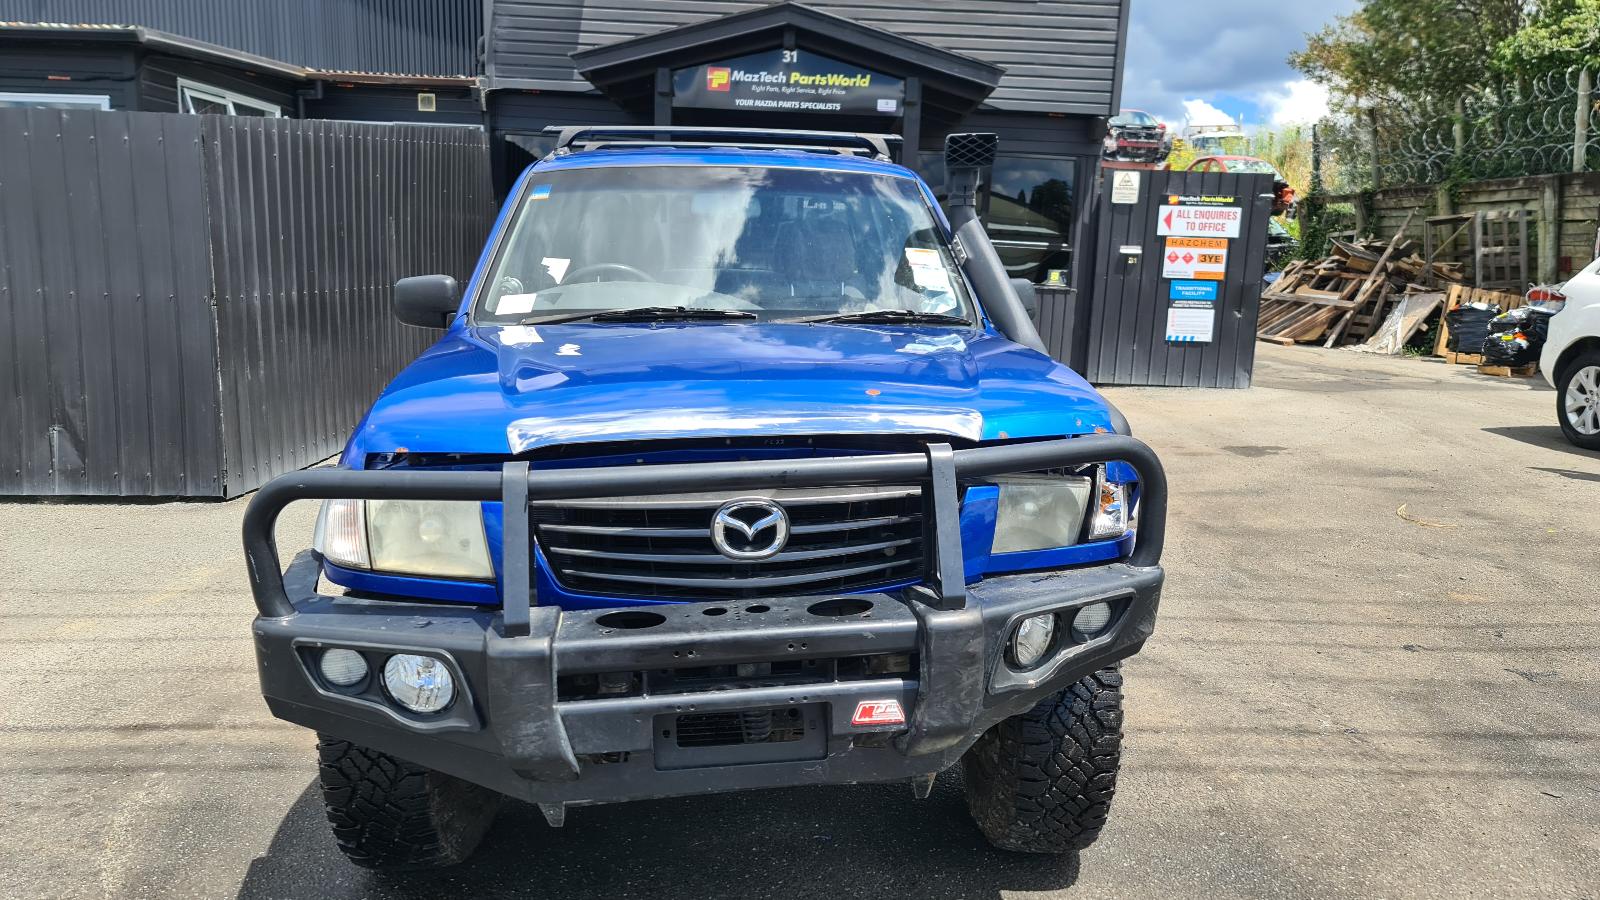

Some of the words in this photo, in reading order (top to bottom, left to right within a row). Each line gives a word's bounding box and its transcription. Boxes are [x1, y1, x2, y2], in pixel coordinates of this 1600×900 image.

[782, 50, 798, 63] 31
[732, 70, 787, 83] MazTech
[790, 72, 871, 88] PartsWorld
[752, 85, 765, 93] Right
[782, 86, 796, 94] Right
[818, 88, 832, 96] Right
[735, 99, 754, 107] YOUR
[754, 100, 778, 108] MAZDA
[778, 101, 800, 109] PARTS
[800, 102, 841, 111] SPECIALISTS
[1177, 210, 1192, 219] ALL
[1194, 210, 1238, 222] ENQUIRIES
[1186, 222, 1196, 231] TO
[1198, 223, 1227, 232] OFFICE
[1171, 239, 1222, 248] HAZCHEM
[1200, 254, 1221, 263] 3YE
